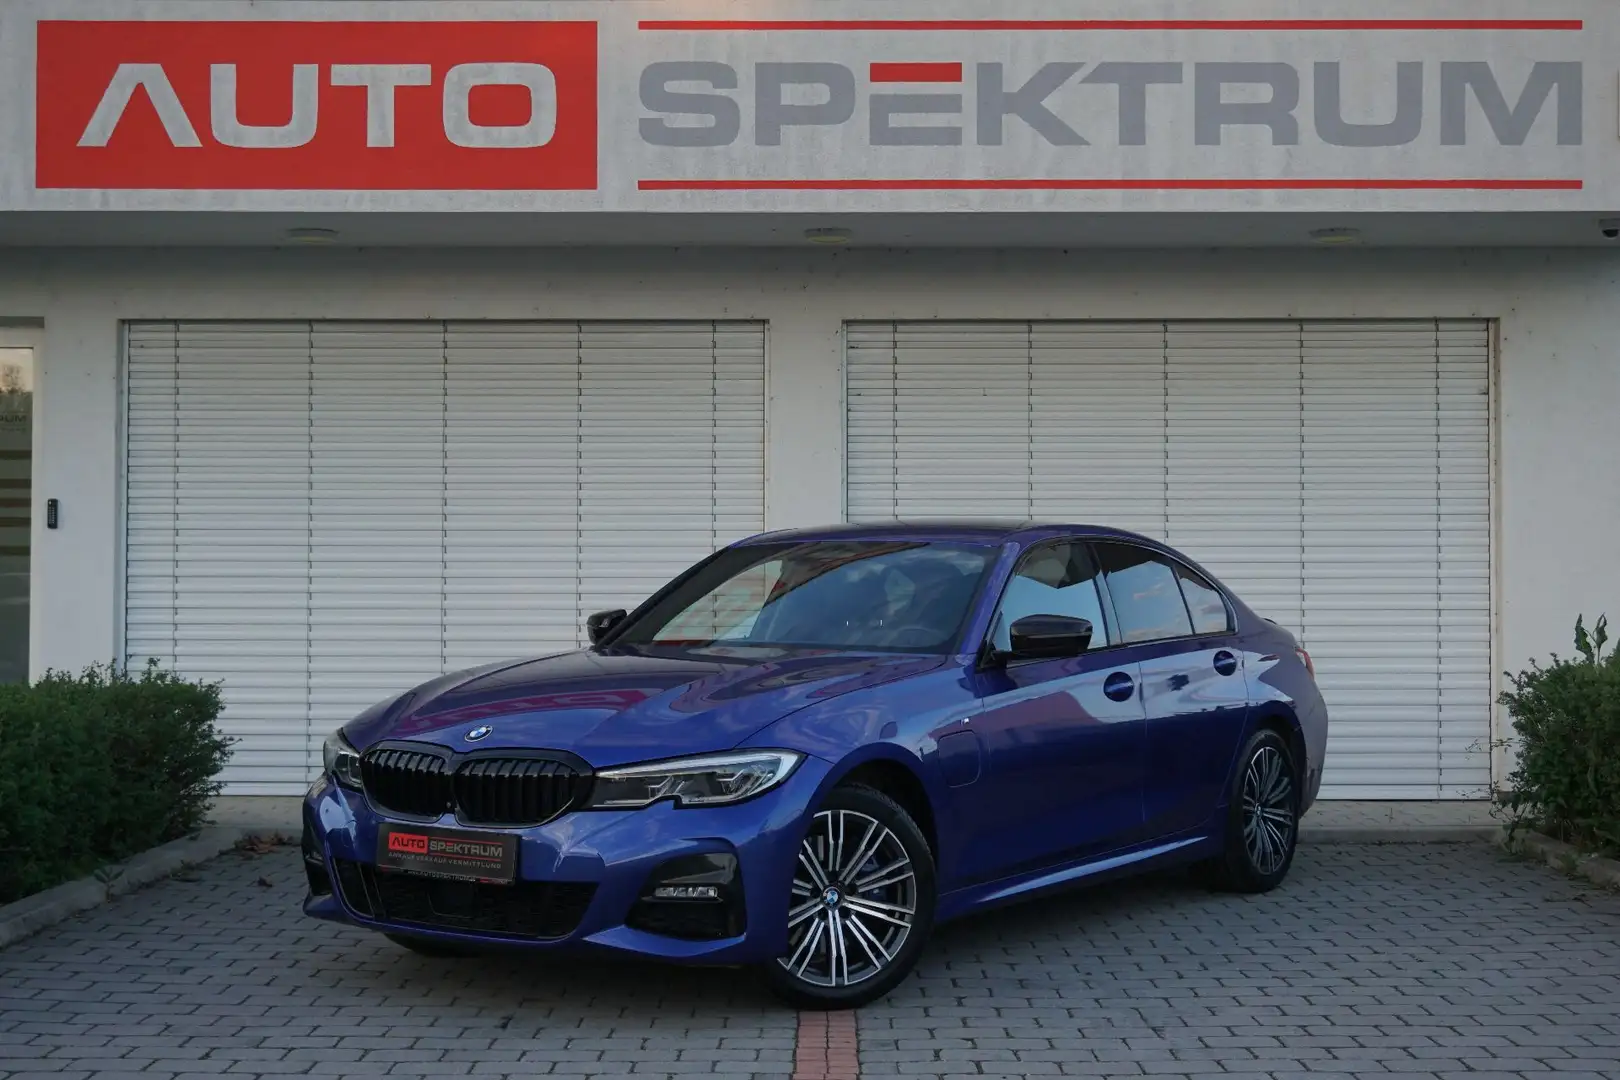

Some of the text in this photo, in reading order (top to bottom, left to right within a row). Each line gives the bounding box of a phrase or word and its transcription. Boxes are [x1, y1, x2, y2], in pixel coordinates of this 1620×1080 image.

[76, 61, 1583, 149] AUTO SPEKTRUM
[391, 836, 503, 858] AUTO SPEKTRUM
[415, 855, 447, 864] VERKAUF
[448, 859, 502, 869] VERMITTLUNG
